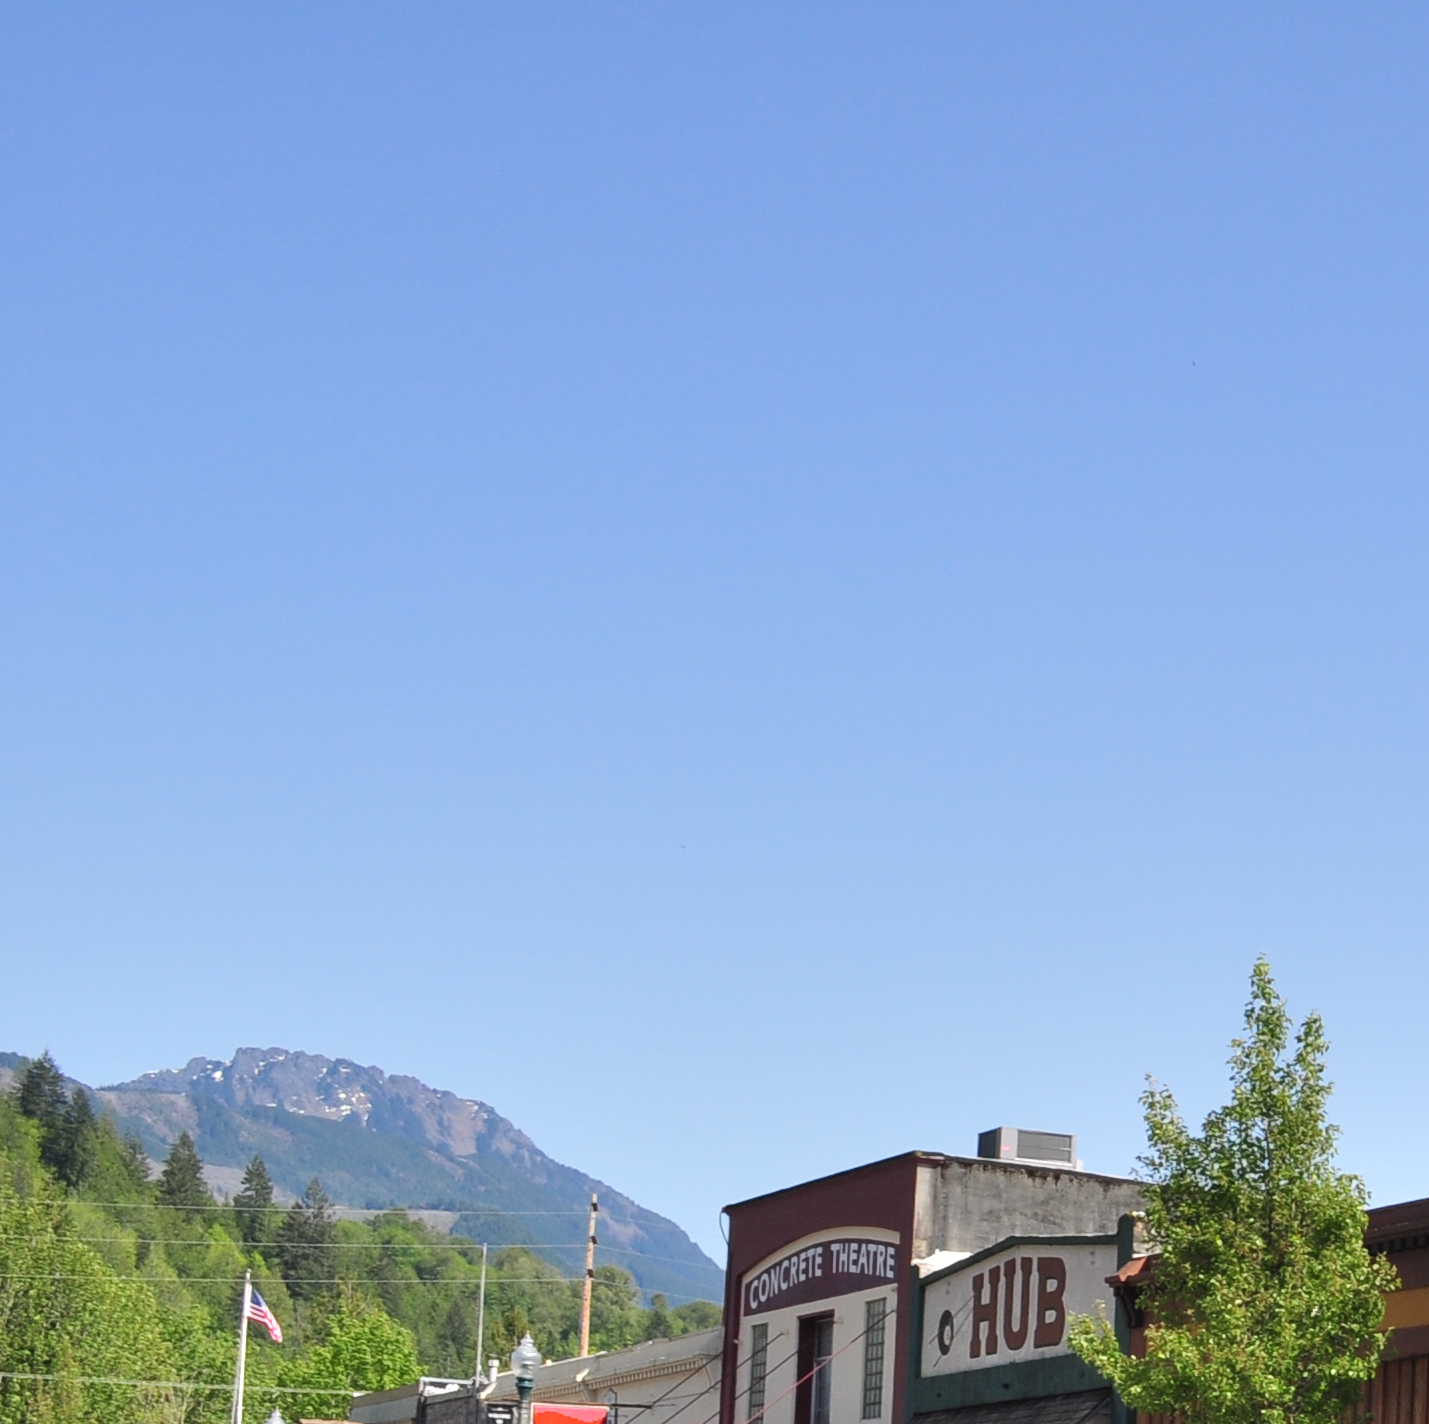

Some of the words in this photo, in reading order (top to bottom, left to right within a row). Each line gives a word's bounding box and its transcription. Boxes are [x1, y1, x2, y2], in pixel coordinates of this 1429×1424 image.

[750, 1246, 823, 1311] CONCRETE
[830, 1242, 896, 1279] THEATRE
[969, 1256, 1067, 1359] HUB
